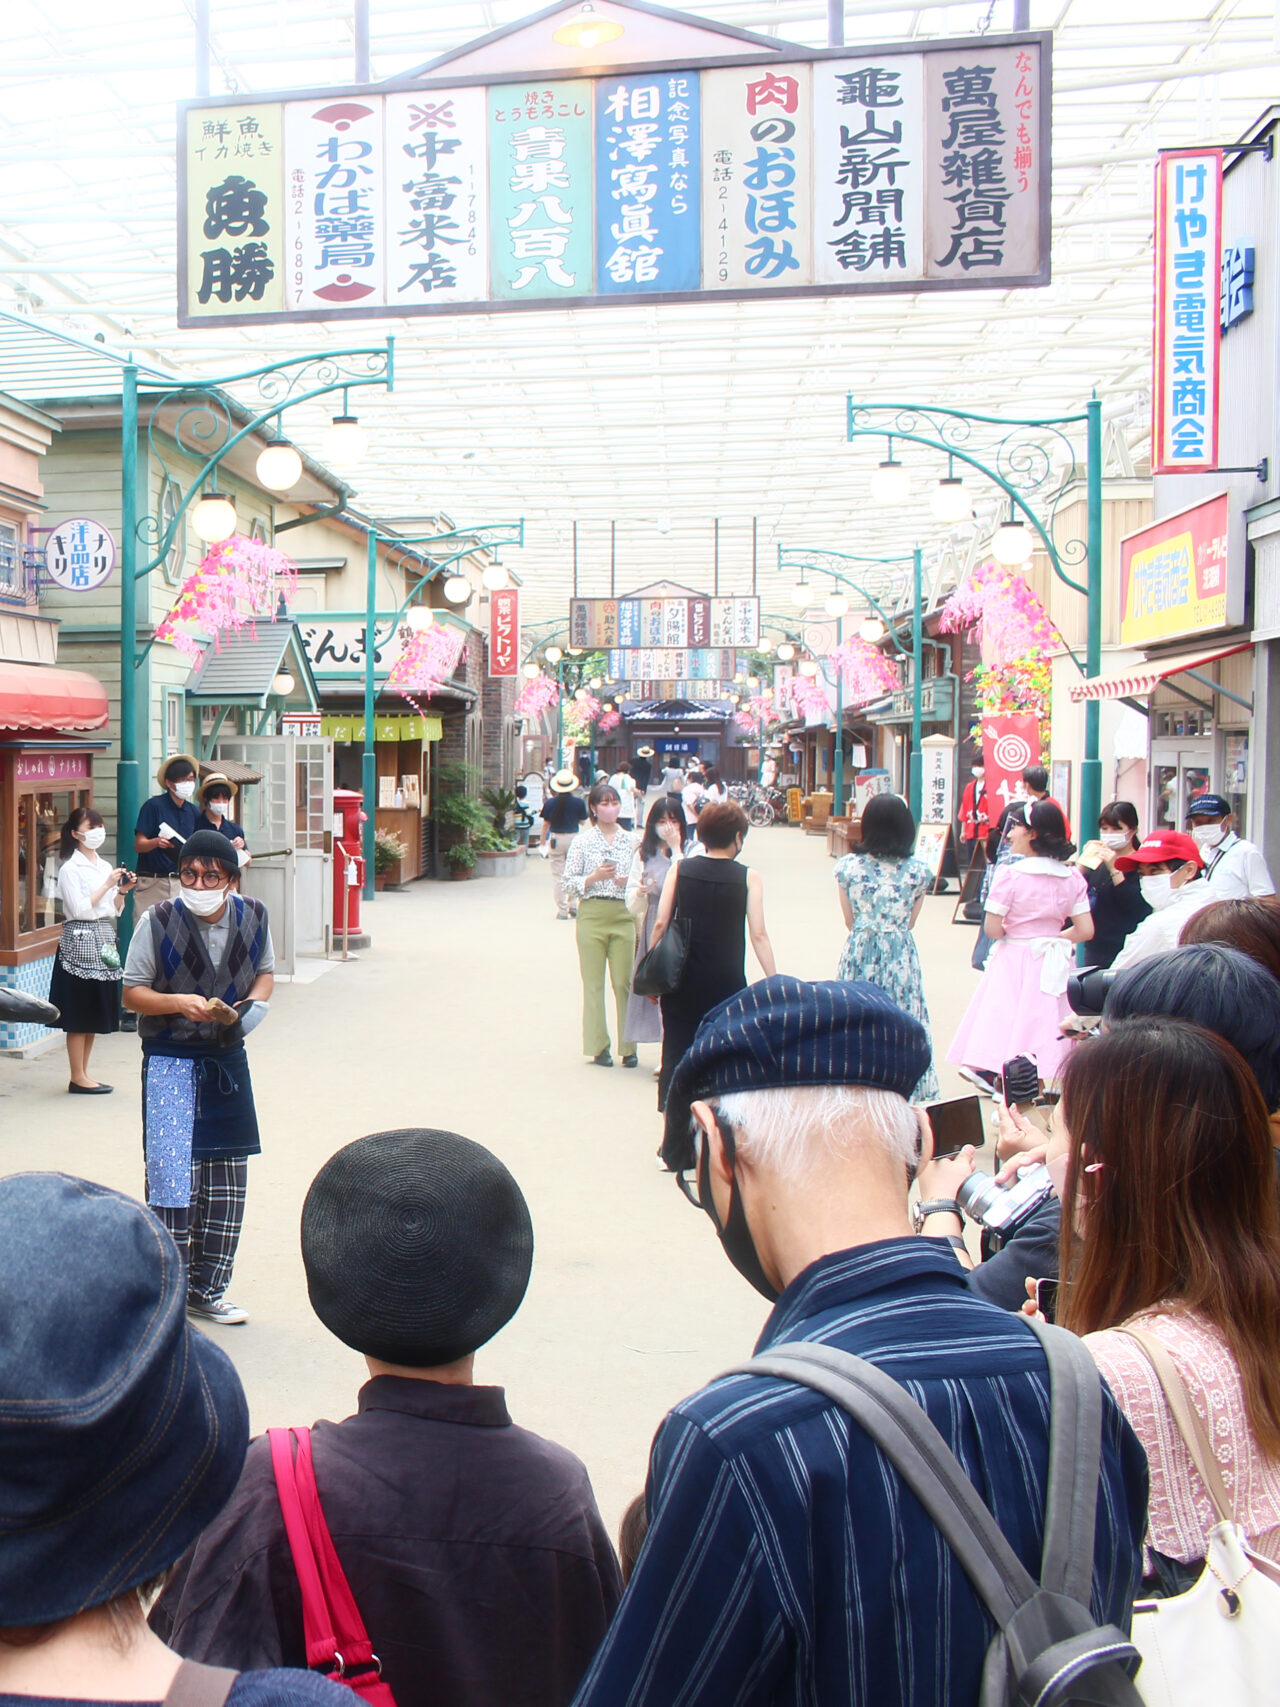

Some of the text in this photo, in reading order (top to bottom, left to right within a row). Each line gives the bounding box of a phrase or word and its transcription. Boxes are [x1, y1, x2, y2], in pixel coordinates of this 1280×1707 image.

[494, 103, 586, 122] とうもろこし
[524, 90, 555, 106] 焼き
[1014, 51, 1032, 193] なんでも揃う
[194, 141, 274, 161] イカ焼き
[201, 116, 266, 143] 鮮魚
[667, 79, 691, 215] 記念写真なら
[743, 71, 800, 279] 肉のおほみ
[507, 125, 576, 290] 青果八百八
[1171, 163, 1208, 459] けやき電気商会
[70, 522, 90, 586] 洋品店
[17, 759, 44, 775] おしゃれ
[932, 776, 946, 823] 相澤寫
